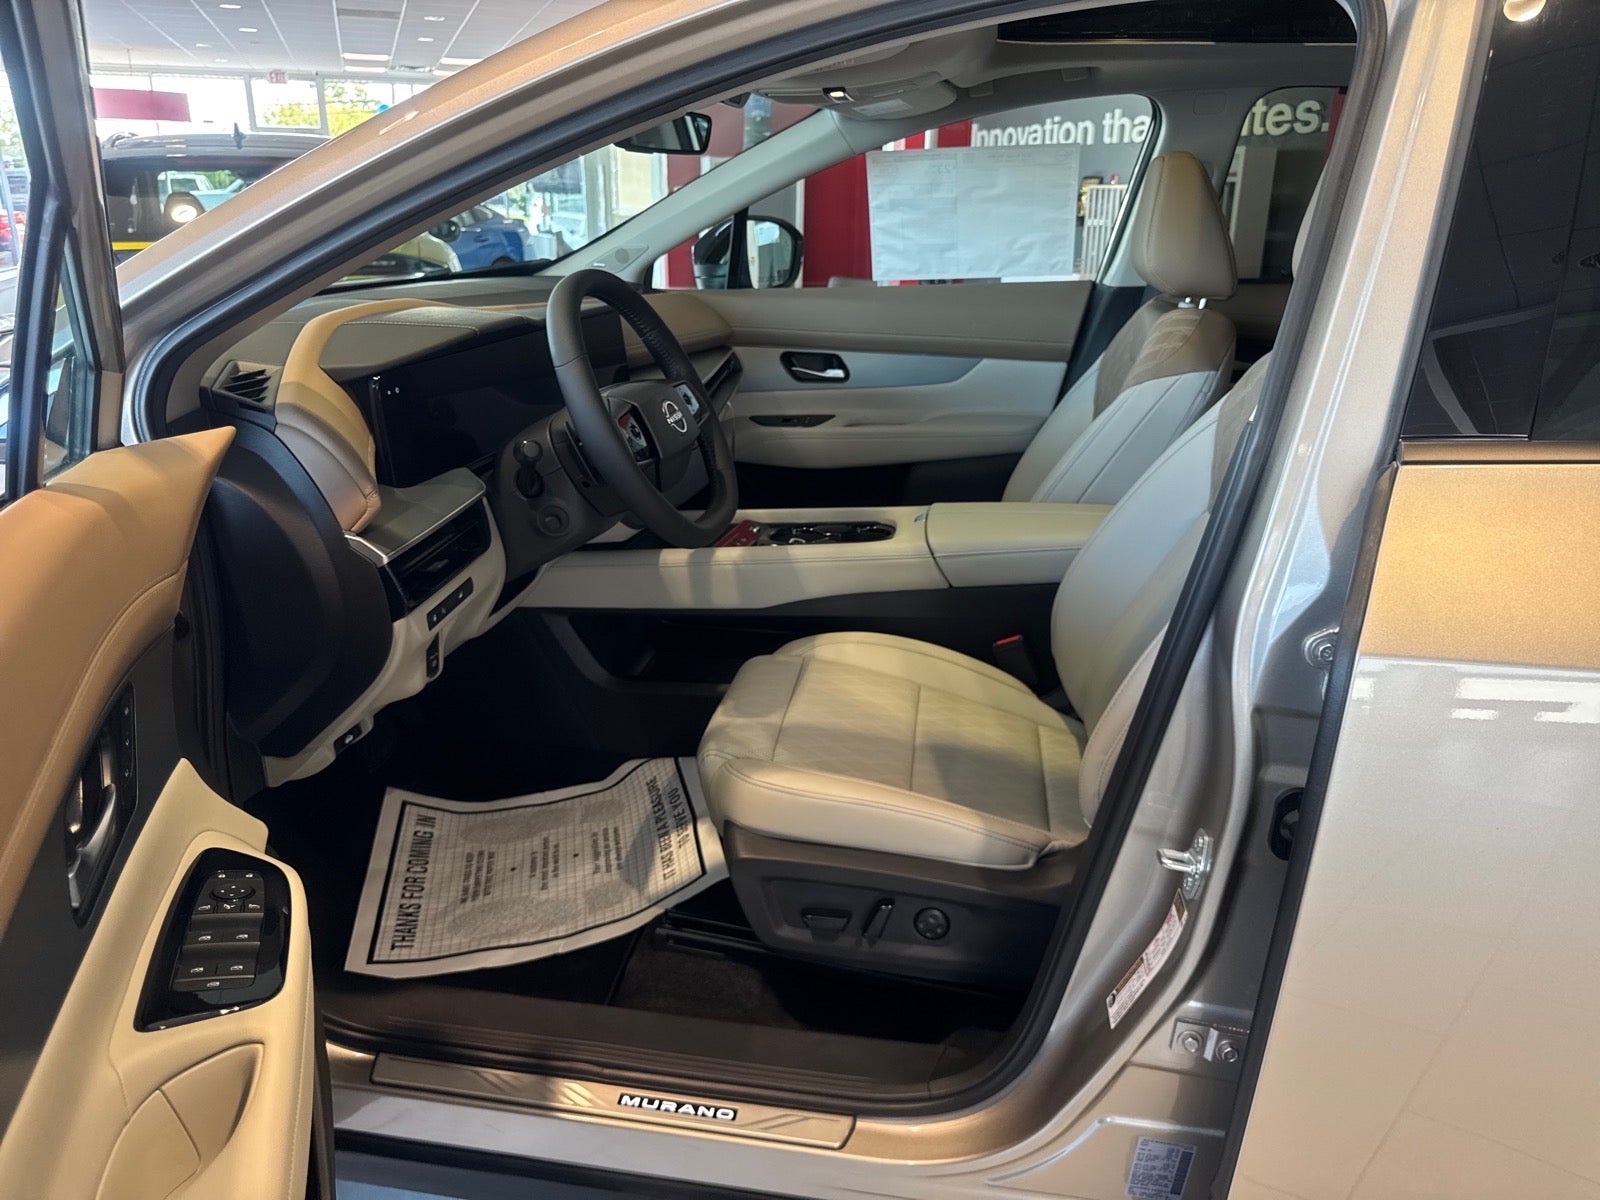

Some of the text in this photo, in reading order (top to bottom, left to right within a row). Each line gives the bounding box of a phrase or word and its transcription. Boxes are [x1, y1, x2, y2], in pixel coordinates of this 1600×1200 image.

[971, 108, 1151, 148] Innovation tha
[646, 775, 667, 824] PLEASURE
[668, 787, 682, 810] YOU
[657, 831, 672, 853] BEEN
[660, 850, 675, 869] HAS
[390, 814, 437, 951] THANKS FOR COMING IN
[663, 868, 677, 880] IT
[620, 1094, 735, 1120] MURANO
